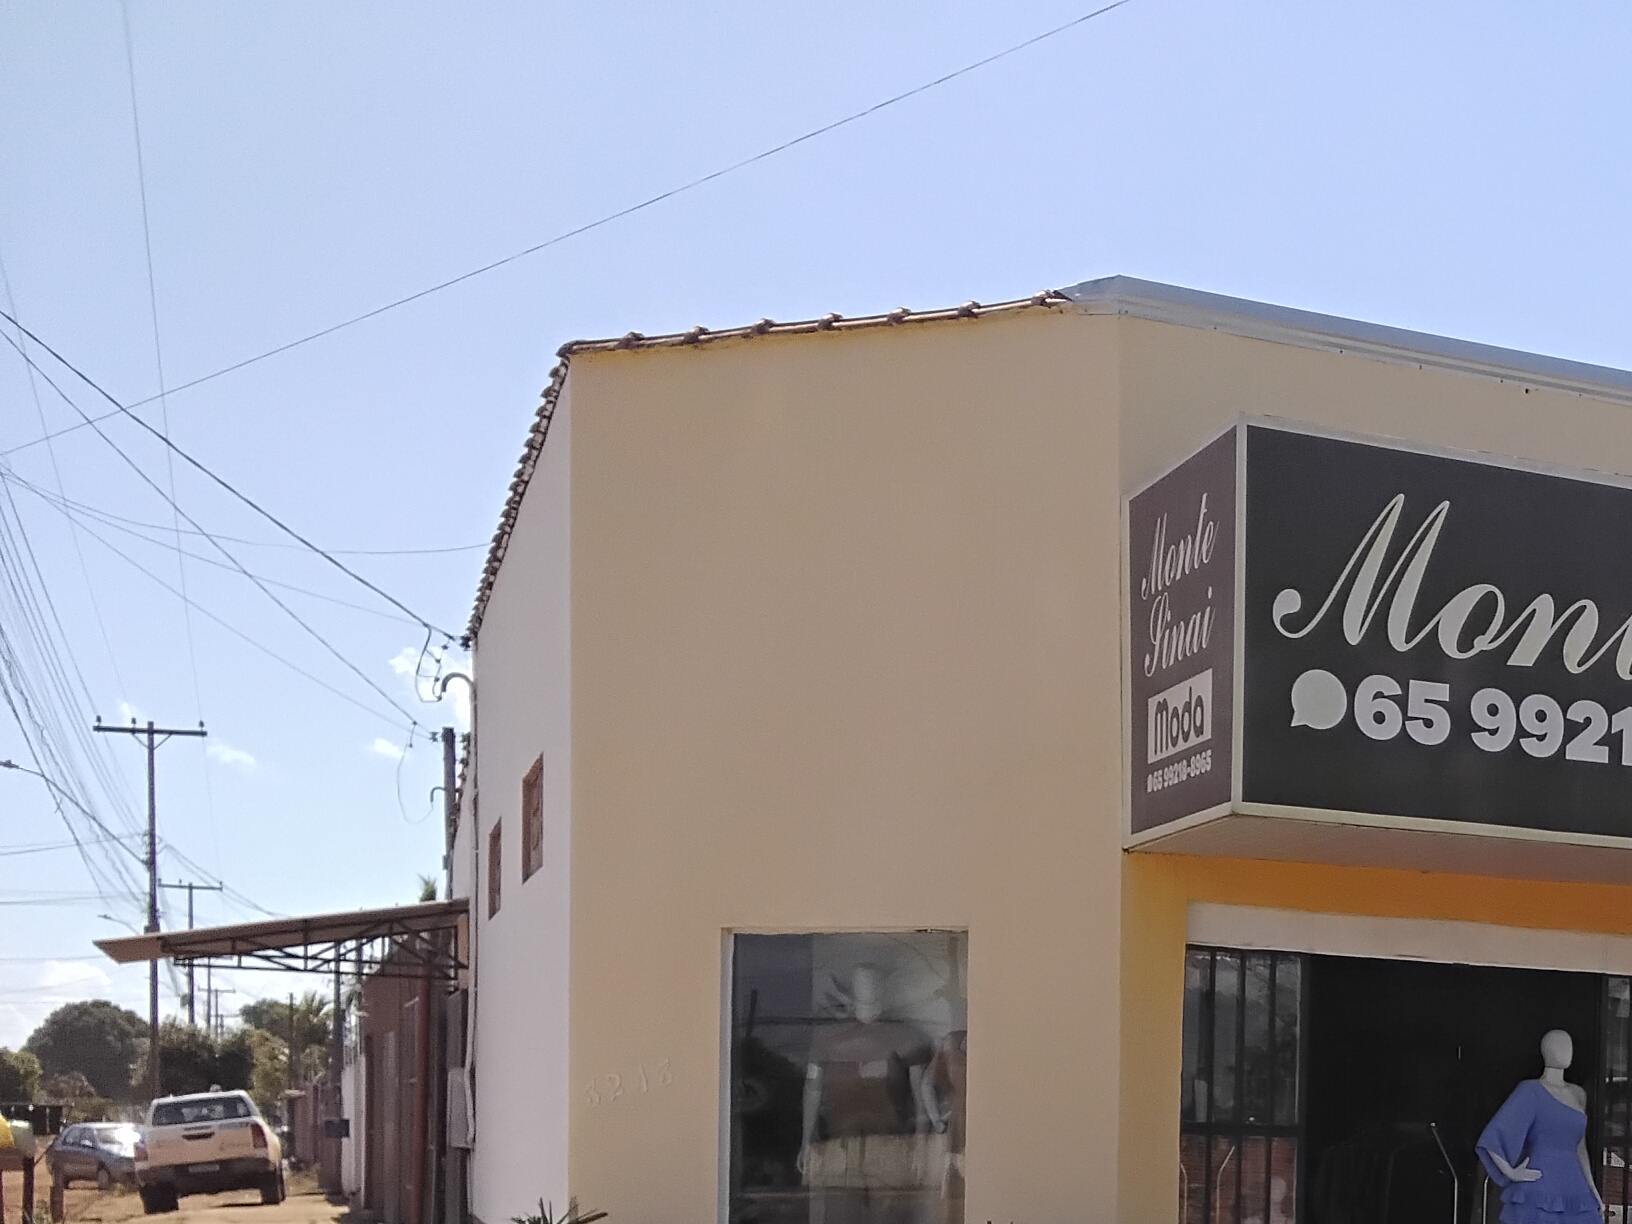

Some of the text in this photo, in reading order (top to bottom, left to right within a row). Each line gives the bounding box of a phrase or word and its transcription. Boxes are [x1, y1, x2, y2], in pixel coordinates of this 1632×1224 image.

[1141, 492, 1219, 600] Monte
[1144, 585, 1216, 678] Sinai
[1353, 674, 1452, 746] 65
[1163, 748, 1212, 788] 99218-8965
